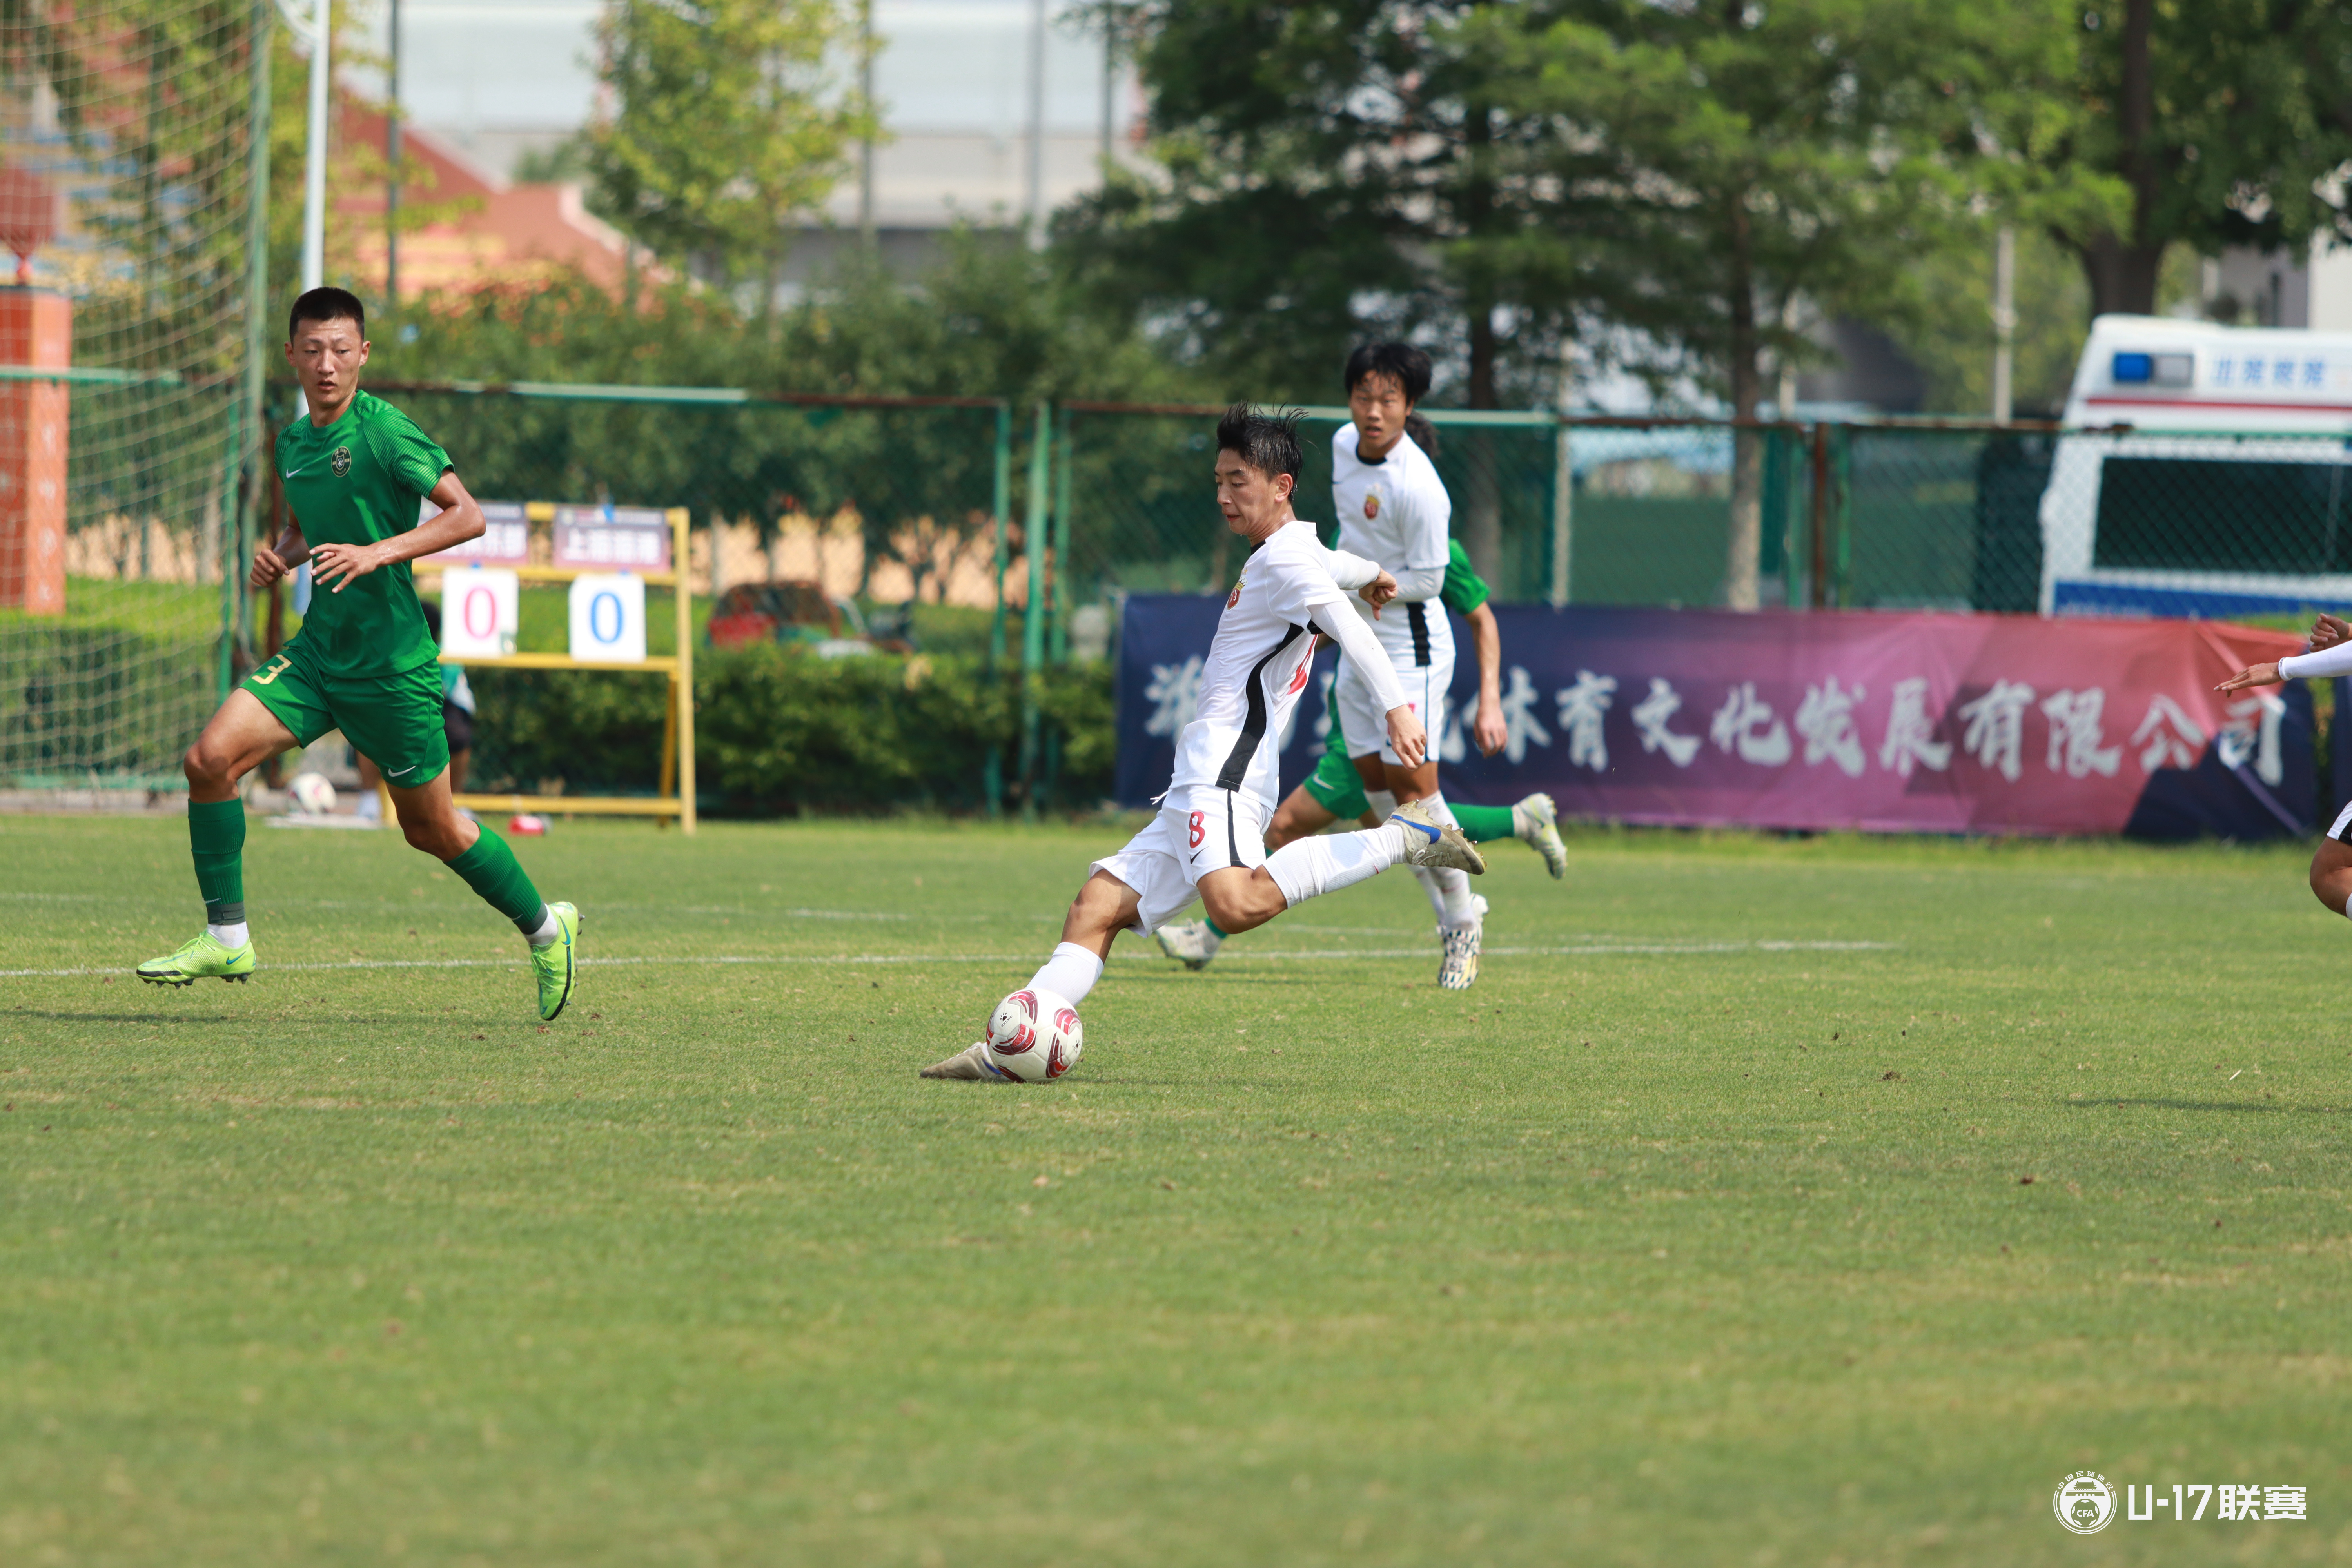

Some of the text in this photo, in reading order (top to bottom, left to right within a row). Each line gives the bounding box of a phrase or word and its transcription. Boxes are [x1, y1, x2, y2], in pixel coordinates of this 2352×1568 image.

[464, 587, 496, 639] 0
[591, 592, 623, 643] 0
[252, 654, 292, 684] 3
[1189, 811, 1205, 849] 8
[1001, 1015, 1013, 1027] KELME
